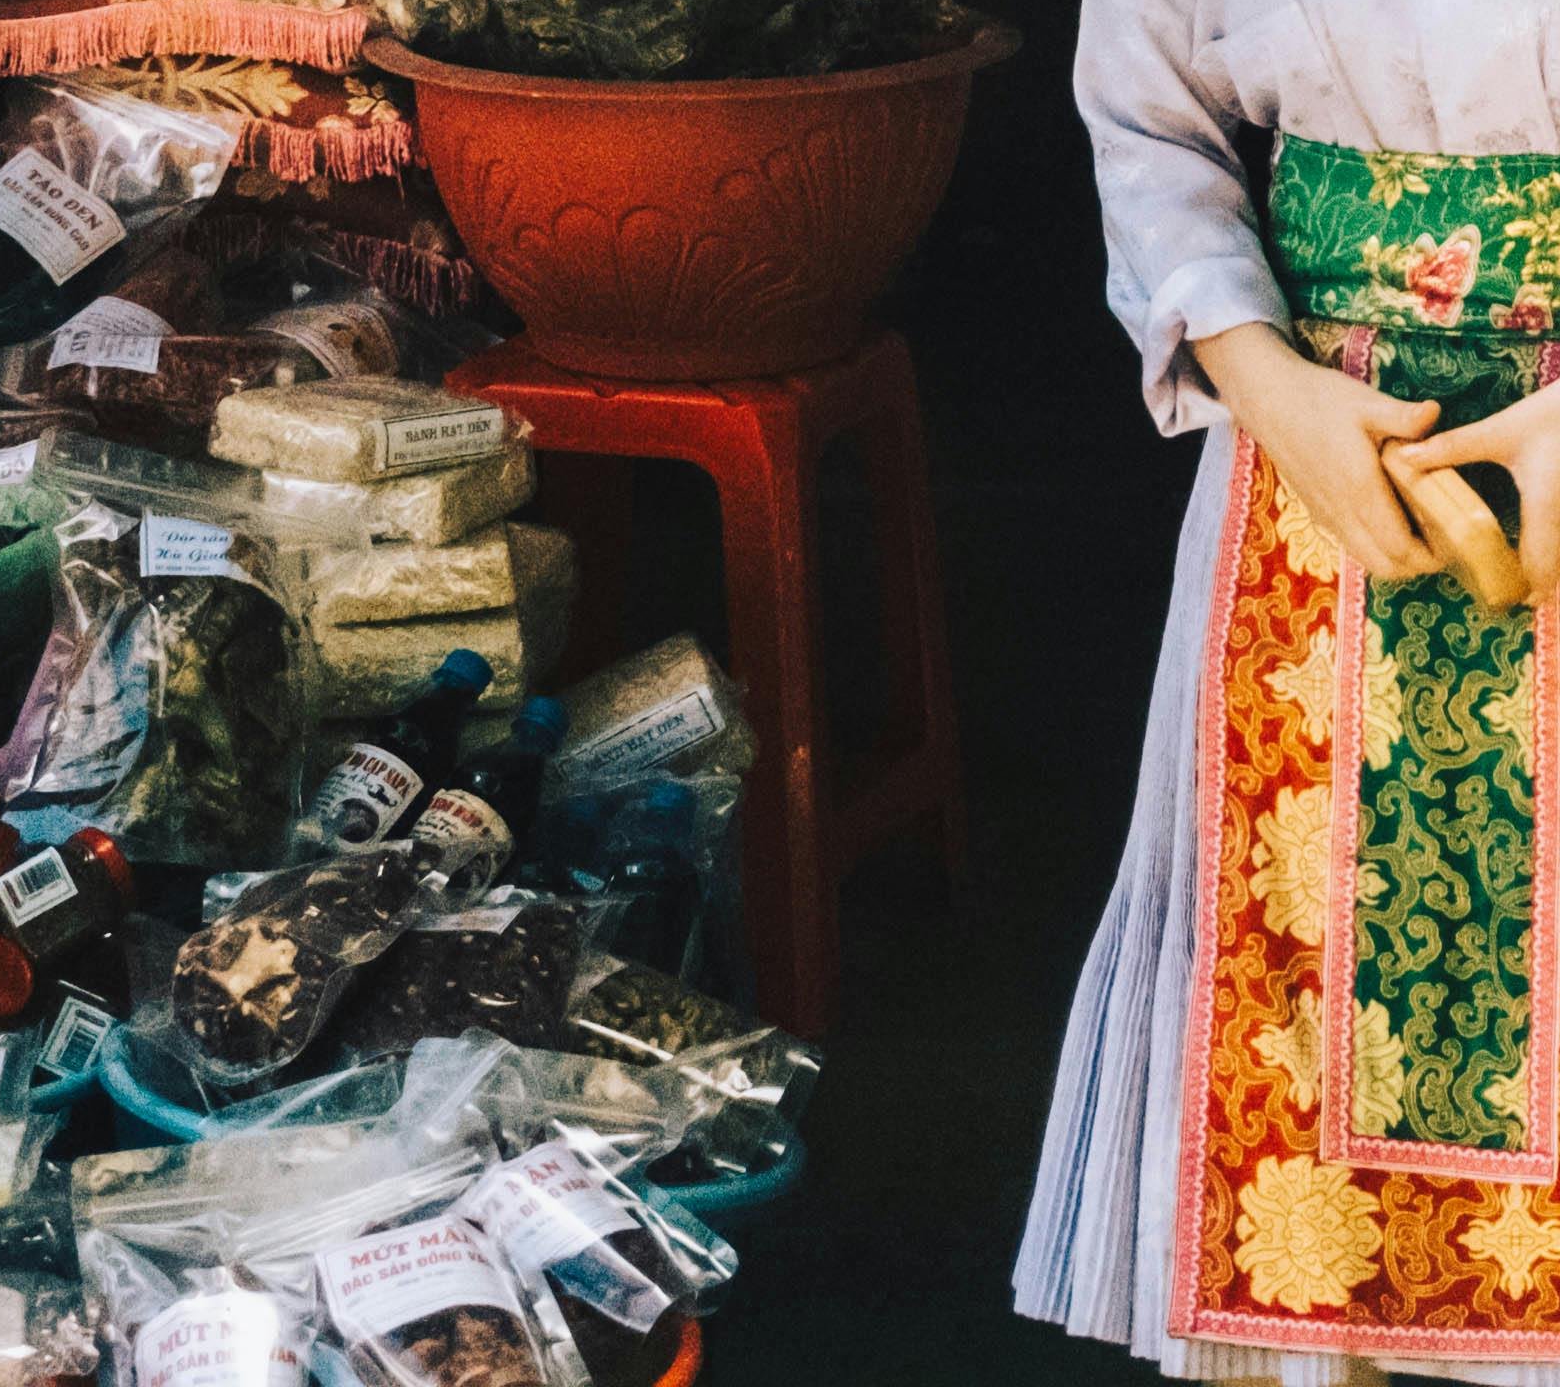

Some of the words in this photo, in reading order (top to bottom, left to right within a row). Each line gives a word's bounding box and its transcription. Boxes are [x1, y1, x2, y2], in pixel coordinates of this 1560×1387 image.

[26, 168, 65, 201] TÁO
[348, 1237, 414, 1272] MỨT
[378, 1263, 413, 1287] SẢN
[415, 1249, 462, 1275] ĐỒNG
[157, 1319, 215, 1359] MỨT
